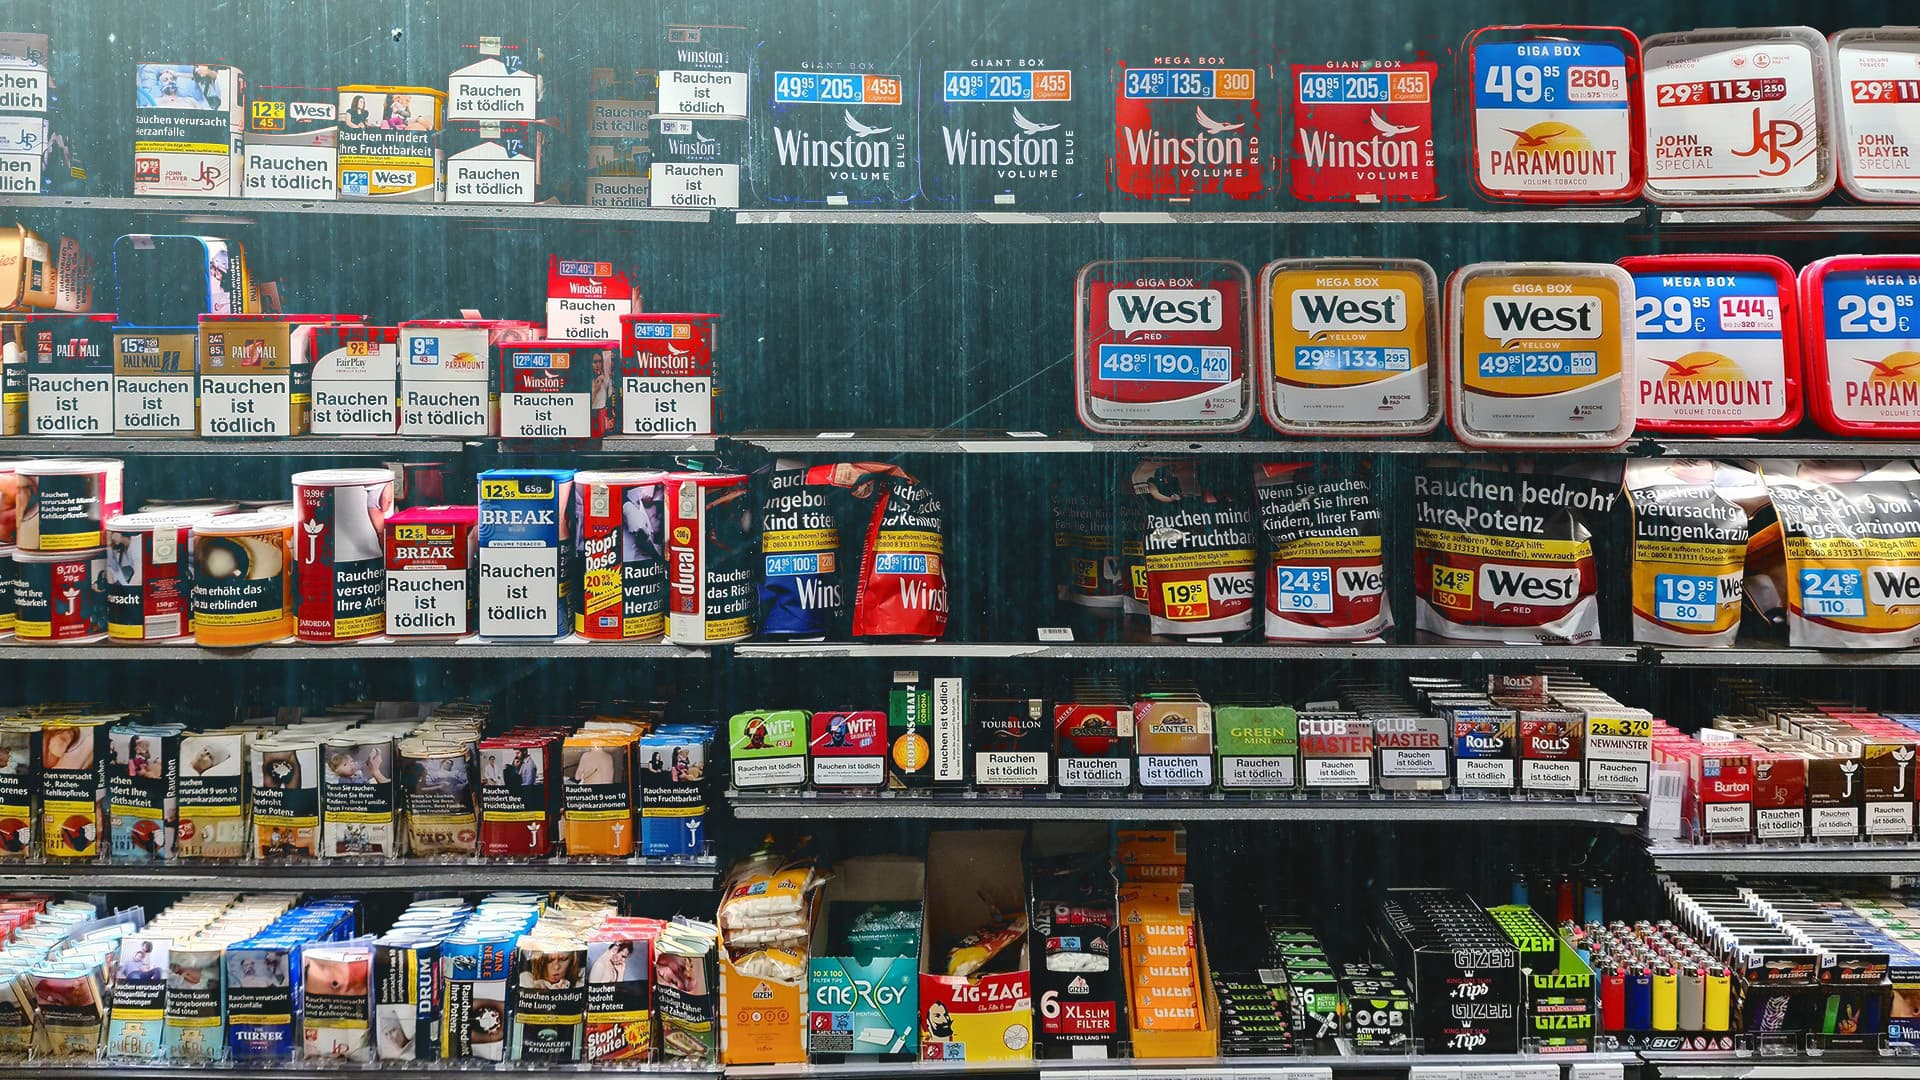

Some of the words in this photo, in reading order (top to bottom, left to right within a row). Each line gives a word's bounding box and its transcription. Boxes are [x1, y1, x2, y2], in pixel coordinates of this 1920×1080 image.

[677, 49, 722, 64] Winston
[1517, 46, 1551, 56] GIGA
[1554, 45, 1582, 56] BOX
[971, 59, 1012, 67] GIANT
[1020, 58, 1044, 67] BOX
[1154, 56, 1191, 65] MEGA
[1198, 56, 1225, 65] BOX
[459, 84, 521, 98] Rauchen
[1764, 84, 1784, 94] 250
[294, 104, 332, 118] West
[456, 99, 474, 112] ist
[476, 98, 524, 112] tödlich
[174, 114, 227, 128] verursacht
[338, 131, 379, 144] Rauchen
[384, 132, 428, 144] mindert
[1655, 134, 1698, 146] JOHN
[340, 144, 360, 156] Ihre
[361, 144, 432, 158] Fruchtbarkeit
[668, 138, 715, 156] Winston
[774, 126, 889, 168] Winston
[897, 133, 905, 168] BLUE
[942, 125, 1058, 166] Winston
[1124, 126, 1242, 166] Winston
[1250, 136, 1258, 165] RED
[1300, 128, 1418, 168] Winston
[1656, 146, 1713, 158] PLAYER
[250, 156, 328, 172] Rauchen
[1490, 150, 1617, 176] PARAMOUNT
[1656, 158, 1713, 170] SPECIAL
[376, 171, 414, 185] West
[830, 172, 890, 181] VOLUME
[1180, 168, 1242, 178] VOLUME
[246, 174, 268, 190] ist
[269, 173, 333, 191] tödlich
[1522, 178, 1552, 186] VOLUME
[1552, 178, 1588, 186] TOBACCO
[1136, 278, 1163, 288] GIGA
[1168, 278, 1194, 288] BOX
[1316, 278, 1349, 288] MEGA
[1354, 278, 1378, 288] BOX
[1663, 276, 1703, 288] MEGA
[1706, 276, 1736, 287] BOX
[1866, 276, 1904, 287] MEGA
[1512, 284, 1543, 294] GIGA
[1547, 284, 1573, 294] BOX
[1117, 296, 1212, 324] West
[1299, 296, 1396, 324] West
[1492, 301, 1591, 332] West
[1330, 334, 1366, 342] YELLOW
[1522, 342, 1560, 350] YELLOW
[444, 361, 485, 372] PARAMOUNT
[636, 350, 688, 369] Winston
[1202, 357, 1227, 372] 420
[28, 378, 110, 393] Rauchen
[202, 379, 286, 394] Rauchen
[626, 378, 706, 394] Rauchen
[408, 392, 480, 406] Rauchen
[1640, 380, 1773, 406] PARAMOUNT
[36, 415, 98, 431] tödlich
[404, 410, 424, 424] ist
[428, 409, 485, 425] tödlich
[210, 417, 276, 434] tödlich
[634, 417, 697, 433] tödlich
[1318, 480, 1369, 496] rauchen,
[1414, 476, 1514, 504] Rauchen
[1522, 480, 1616, 514] bedroht
[1336, 494, 1368, 508] Ihren
[482, 510, 554, 525] BREAK
[1638, 500, 1726, 521] verursacht
[1262, 516, 1314, 532] Kindern,
[1316, 510, 1346, 526] Ihrer
[1416, 502, 1457, 524] Ihre
[1464, 506, 1544, 534] Potenz
[1298, 526, 1358, 538] Freunden
[584, 533, 618, 557] Stopf
[1504, 538, 1521, 548] BZgA
[396, 547, 454, 559] BREAK
[1832, 548, 1864, 558] 313131
[586, 551, 617, 572] Dose
[337, 568, 384, 582] Rauchen
[480, 564, 556, 579] Rauchen
[672, 546, 695, 596] ducal
[208, 584, 242, 598] erhöht
[244, 584, 262, 596] das
[388, 578, 464, 593] Rauchen
[1486, 568, 1574, 600] West
[506, 585, 528, 600] ist
[211, 598, 258, 611] erblinden
[337, 600, 362, 611] Ihre
[1512, 606, 1532, 615] RED
[395, 613, 456, 628] tödlich
[488, 606, 547, 622] tödlich
[940, 682, 949, 720] tödlich
[846, 718, 877, 734] WTF!
[940, 722, 949, 736] ist
[981, 720, 1042, 730] TOURBILLON
[1152, 725, 1194, 734] PANTER
[1376, 719, 1417, 732] CLUB
[1230, 728, 1285, 738] GREEN
[1244, 738, 1270, 746] MINI
[1376, 734, 1439, 747] MASTER
[1590, 738, 1648, 751] NEWMINSTER
[940, 736, 949, 777] Rauchen
[989, 754, 1036, 764] Rauchen
[1236, 759, 1280, 768] Rauchen
[1002, 766, 1038, 776] tödlich
[1068, 759, 1118, 769] Rauchen
[1082, 769, 1122, 780] tödlich
[672, 787, 699, 795] mindert
[1714, 780, 1750, 794] Burton
[659, 795, 702, 804] Fruchtbarkeit
[1760, 810, 1801, 820] Rauchen
[494, 950, 504, 972] VAN
[1454, 949, 1515, 969] GIZEH
[418, 958, 432, 1012] DRUM
[1534, 974, 1591, 988] GIZEH
[752, 990, 774, 1000] GIZEH
[1068, 986, 1090, 994] GIZEH
[536, 1002, 558, 1012] Lunge
[1040, 990, 1062, 1019] 6
[1452, 1003, 1512, 1020] GIZEH
[1065, 1005, 1084, 1019] XL
[1084, 1009, 1110, 1018] SLIM
[1356, 1010, 1404, 1026] OCB
[1076, 1020, 1110, 1029] FILTER
[1536, 1015, 1592, 1030] GIZEH
[236, 1031, 284, 1041] TURNER
[1654, 1039, 1680, 1049] BIC
